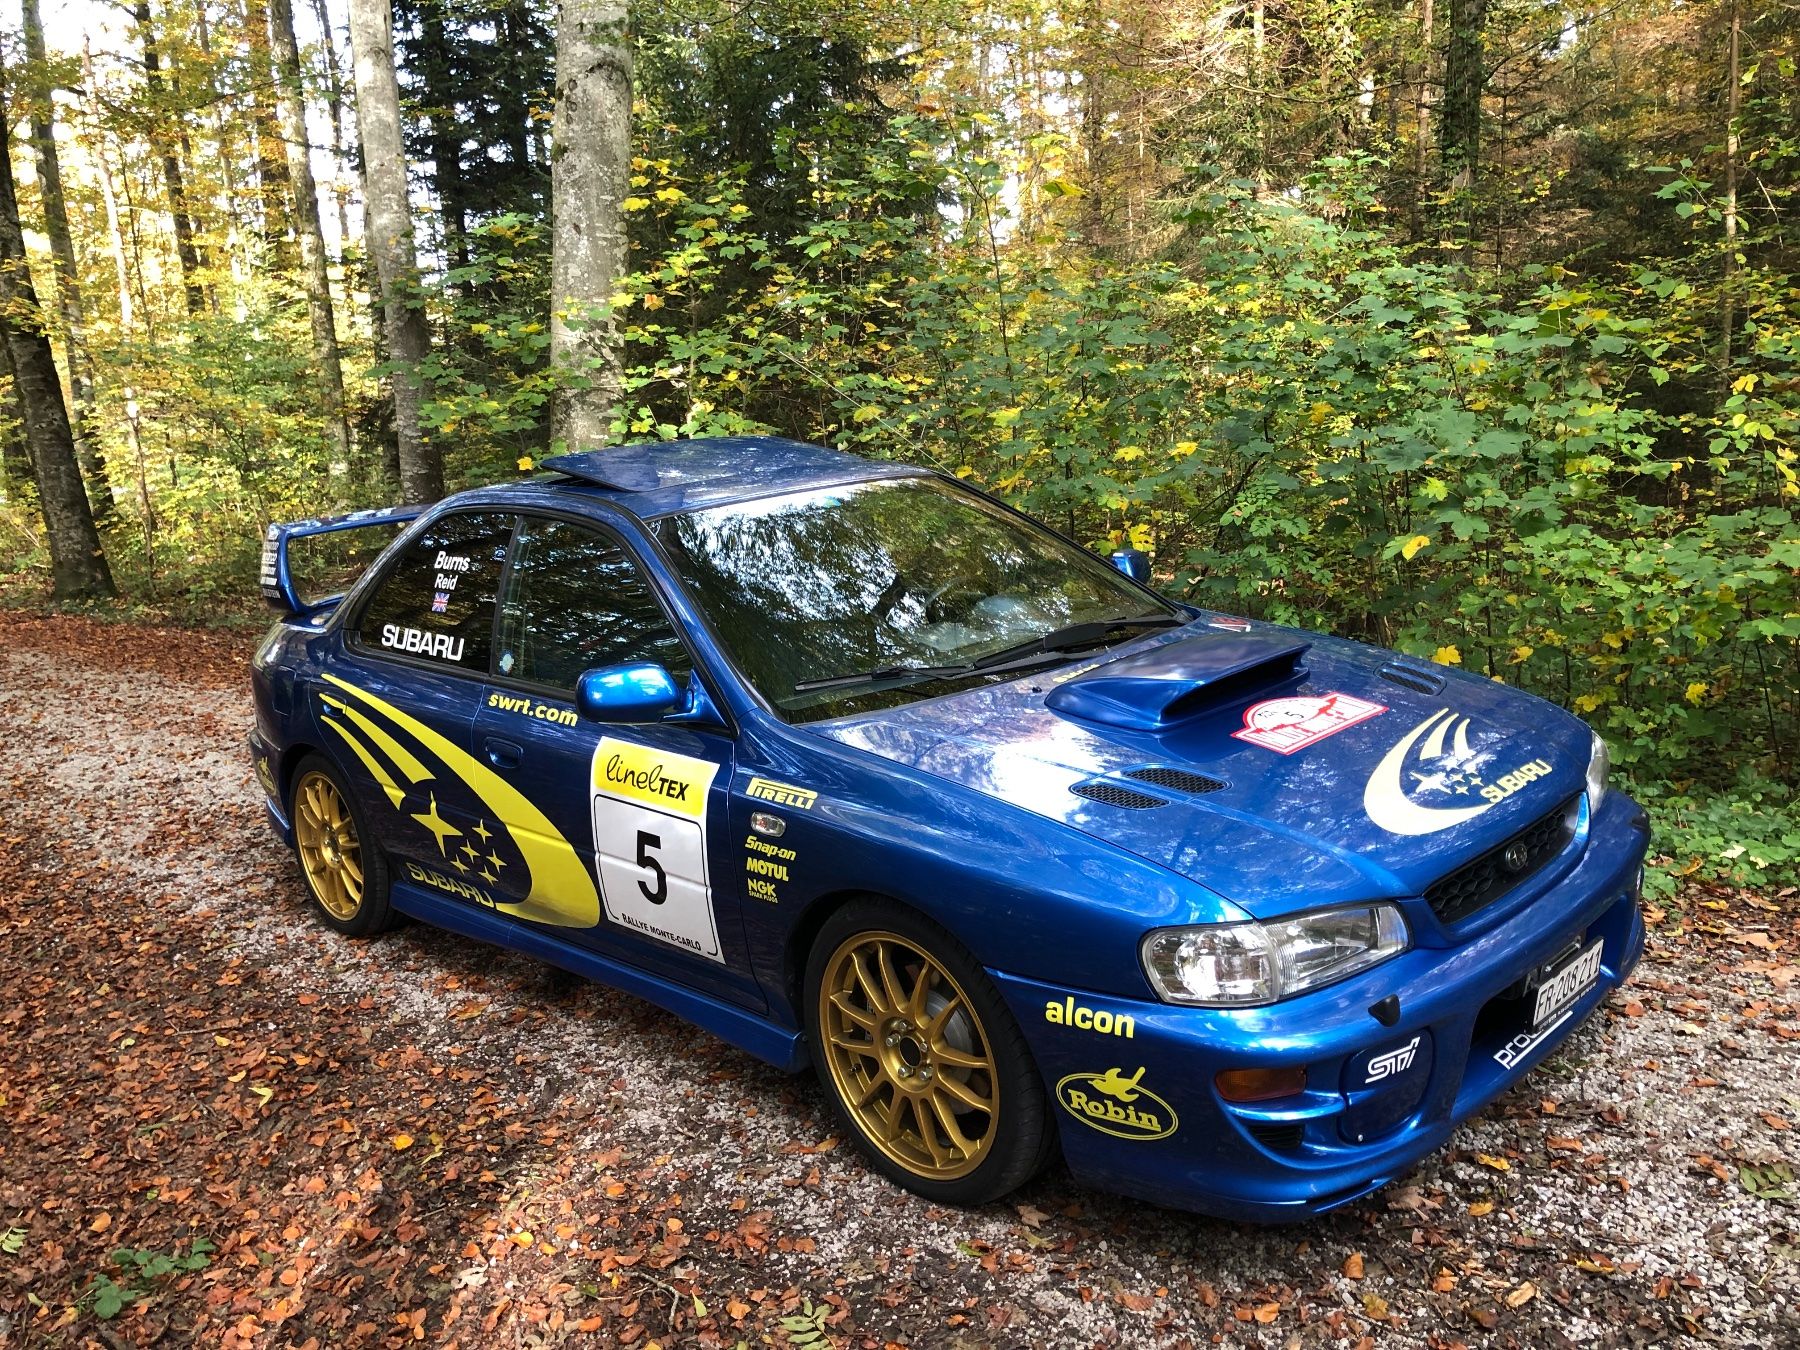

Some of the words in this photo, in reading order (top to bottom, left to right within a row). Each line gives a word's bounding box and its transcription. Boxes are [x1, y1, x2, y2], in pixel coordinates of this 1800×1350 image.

[434, 550, 471, 571] Burns
[434, 573, 459, 590] Reid
[381, 624, 465, 662] SUBARU
[488, 694, 579, 727] swrt.com
[745, 776, 819, 810] PIRELLI
[1480, 758, 1553, 803] SUBARU
[744, 835, 797, 861] Snap-on
[405, 862, 495, 908] SUBARU
[637, 830, 668, 905] 5
[746, 857, 789, 882] MOTUL
[747, 878, 777, 897] NGK
[621, 912, 650, 932] RALLYE
[650, 925, 702, 951] MONTE-CARLO
[1045, 996, 1135, 1039] alcon
[1067, 1088, 1162, 1133] Robin
